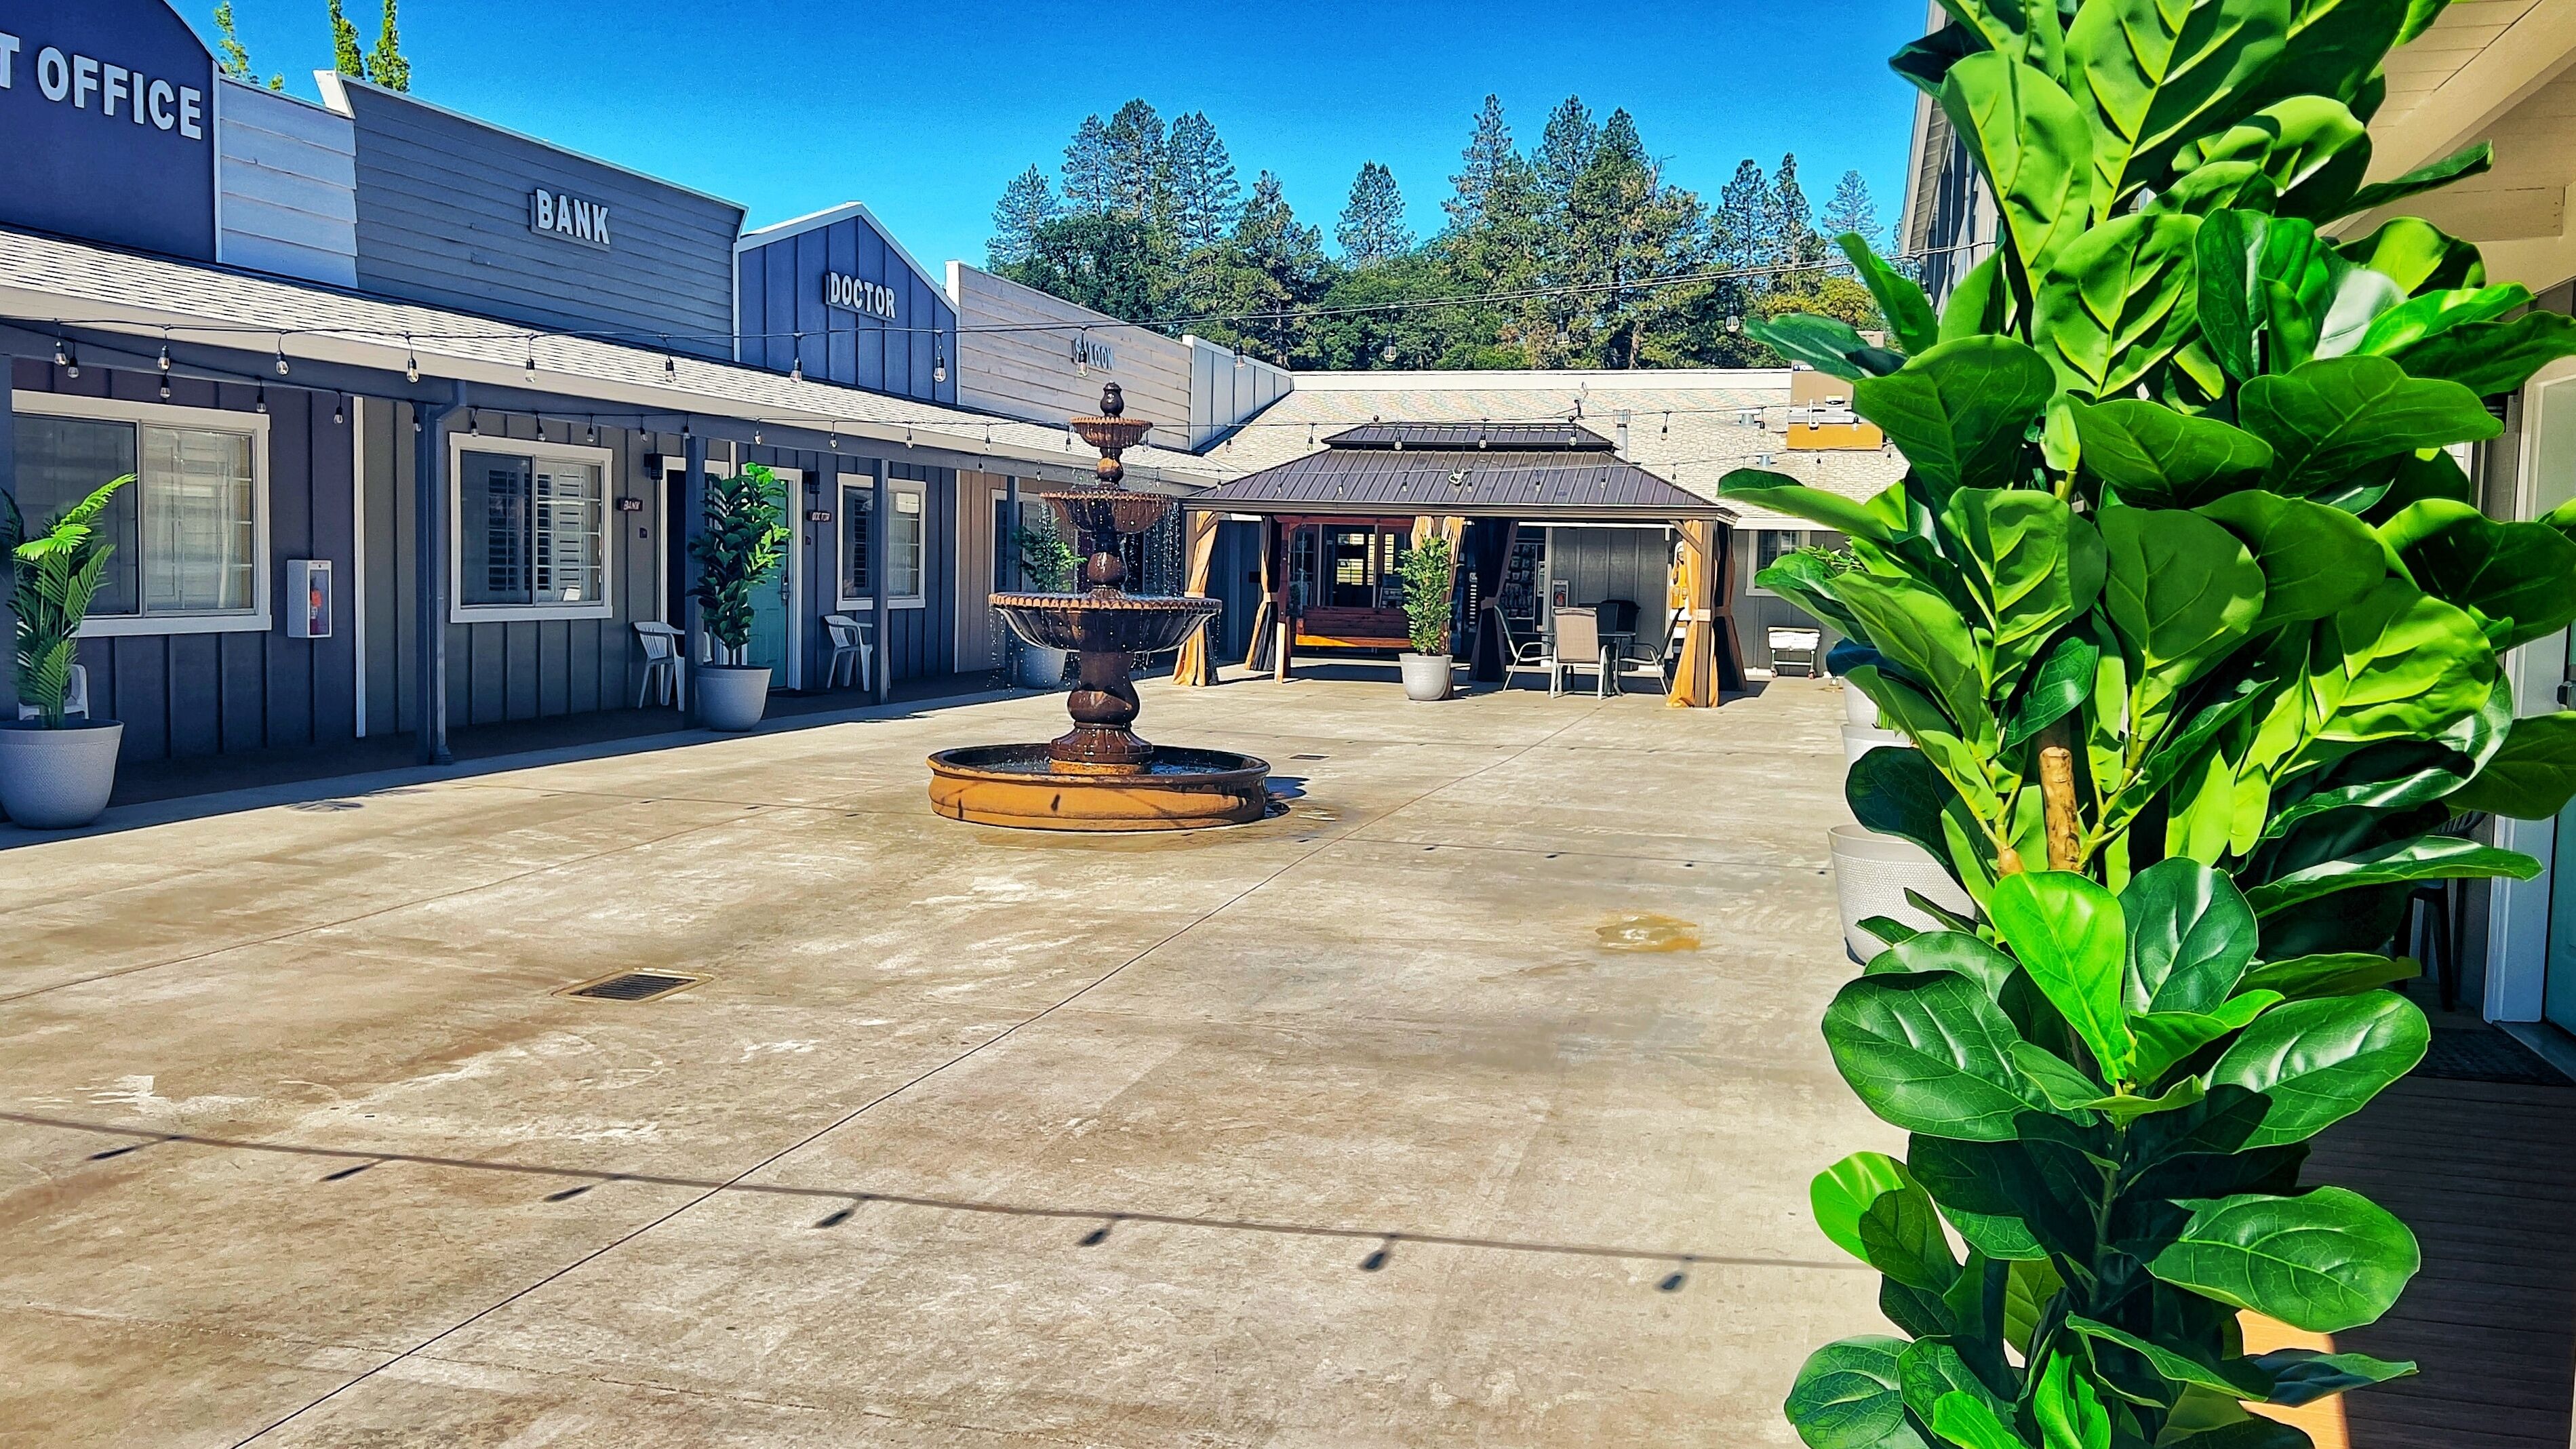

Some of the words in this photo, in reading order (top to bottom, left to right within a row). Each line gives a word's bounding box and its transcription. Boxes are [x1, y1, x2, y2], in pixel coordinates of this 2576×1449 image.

[37, 46, 201, 140] OFFICE
[536, 188, 610, 245] BANK
[830, 271, 896, 319] DOCTOR
[624, 500, 640, 510] BANK
